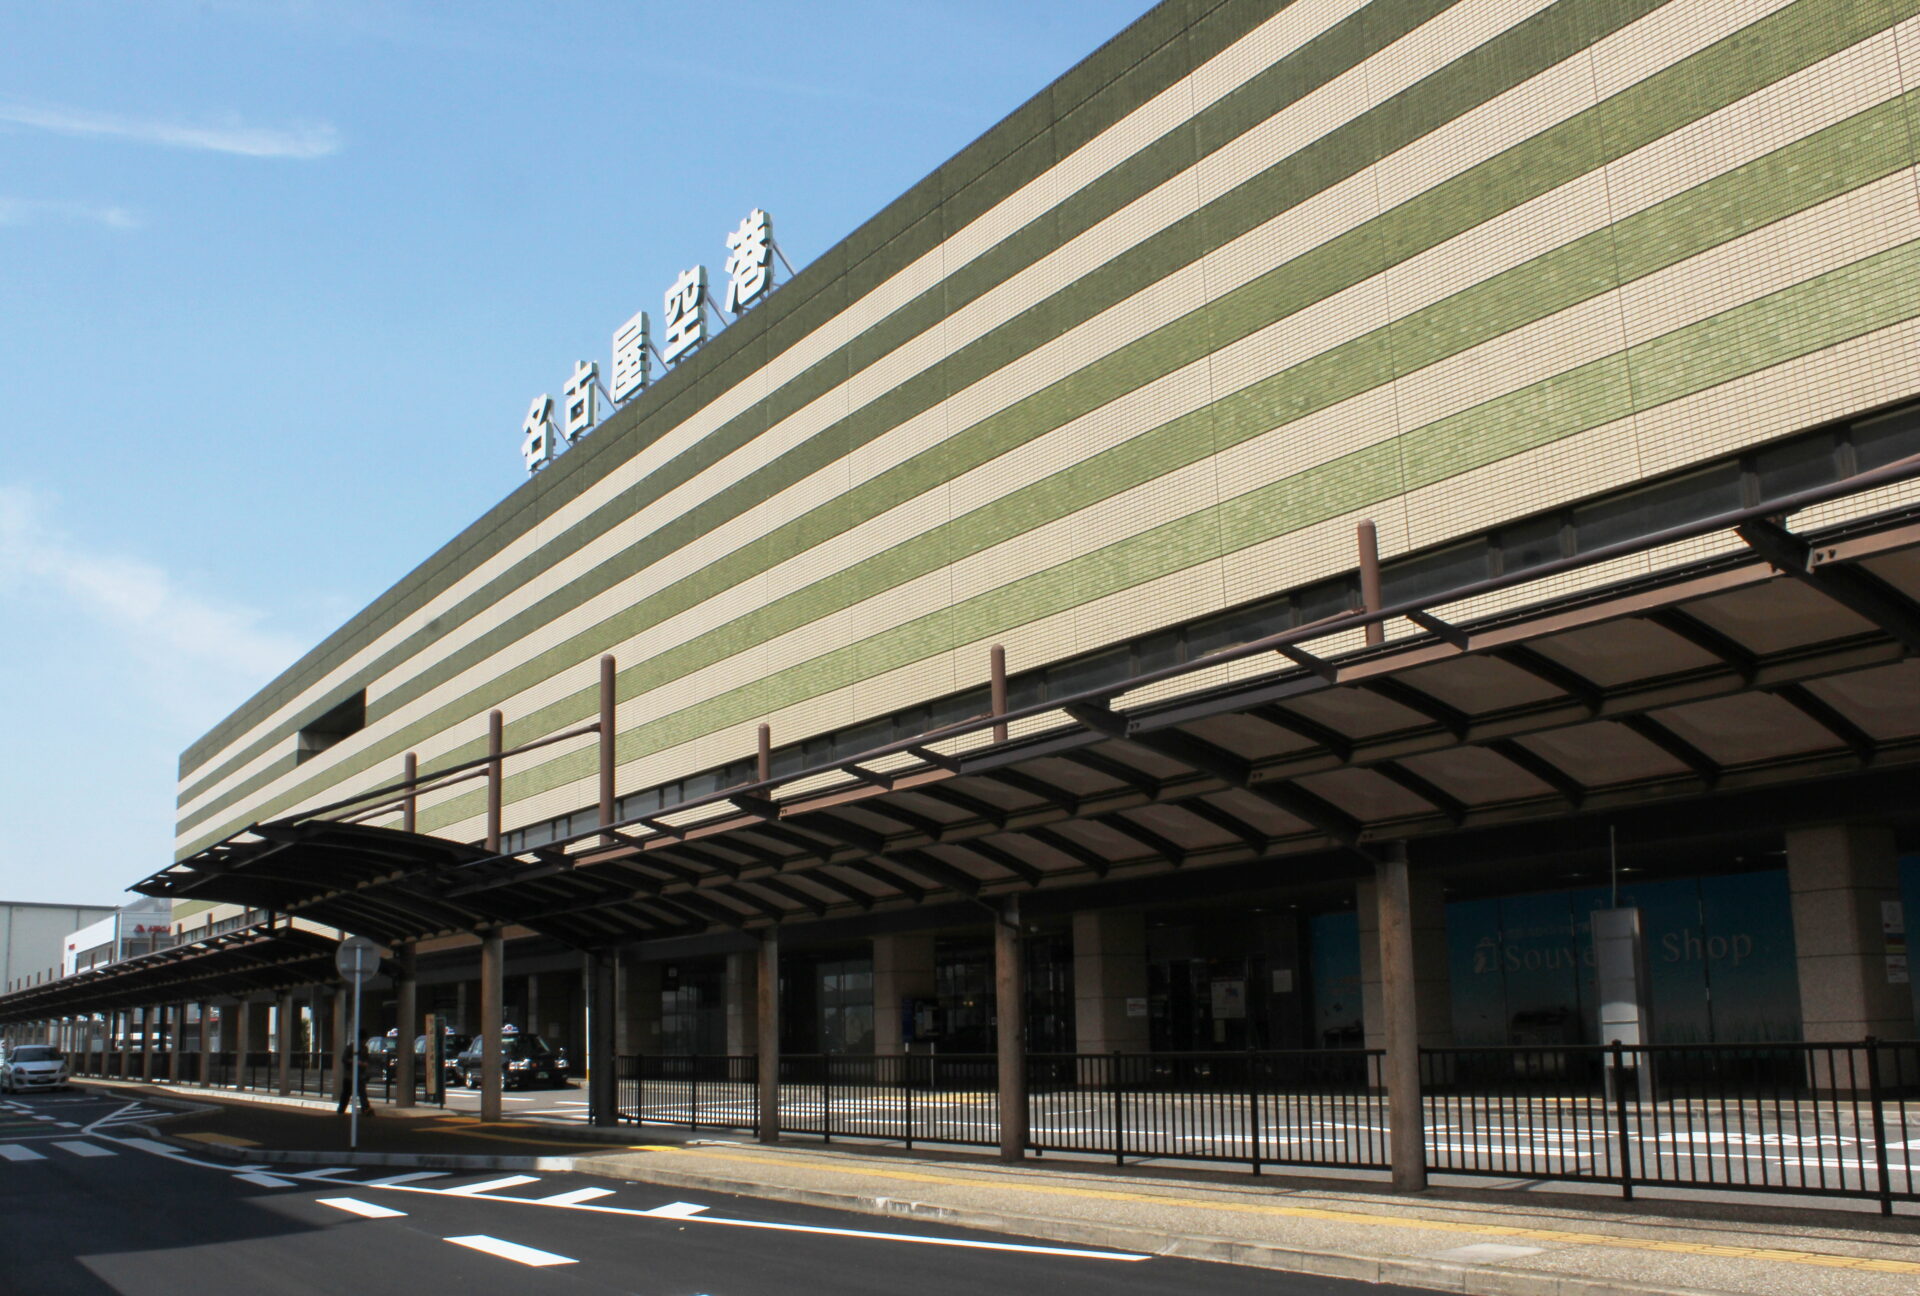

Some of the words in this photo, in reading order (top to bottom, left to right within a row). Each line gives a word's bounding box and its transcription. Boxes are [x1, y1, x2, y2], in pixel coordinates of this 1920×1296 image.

[521, 208, 772, 472] 名古屋空港
[1505, 943, 1597, 973] Souve
[1662, 928, 1753, 966] Shop
